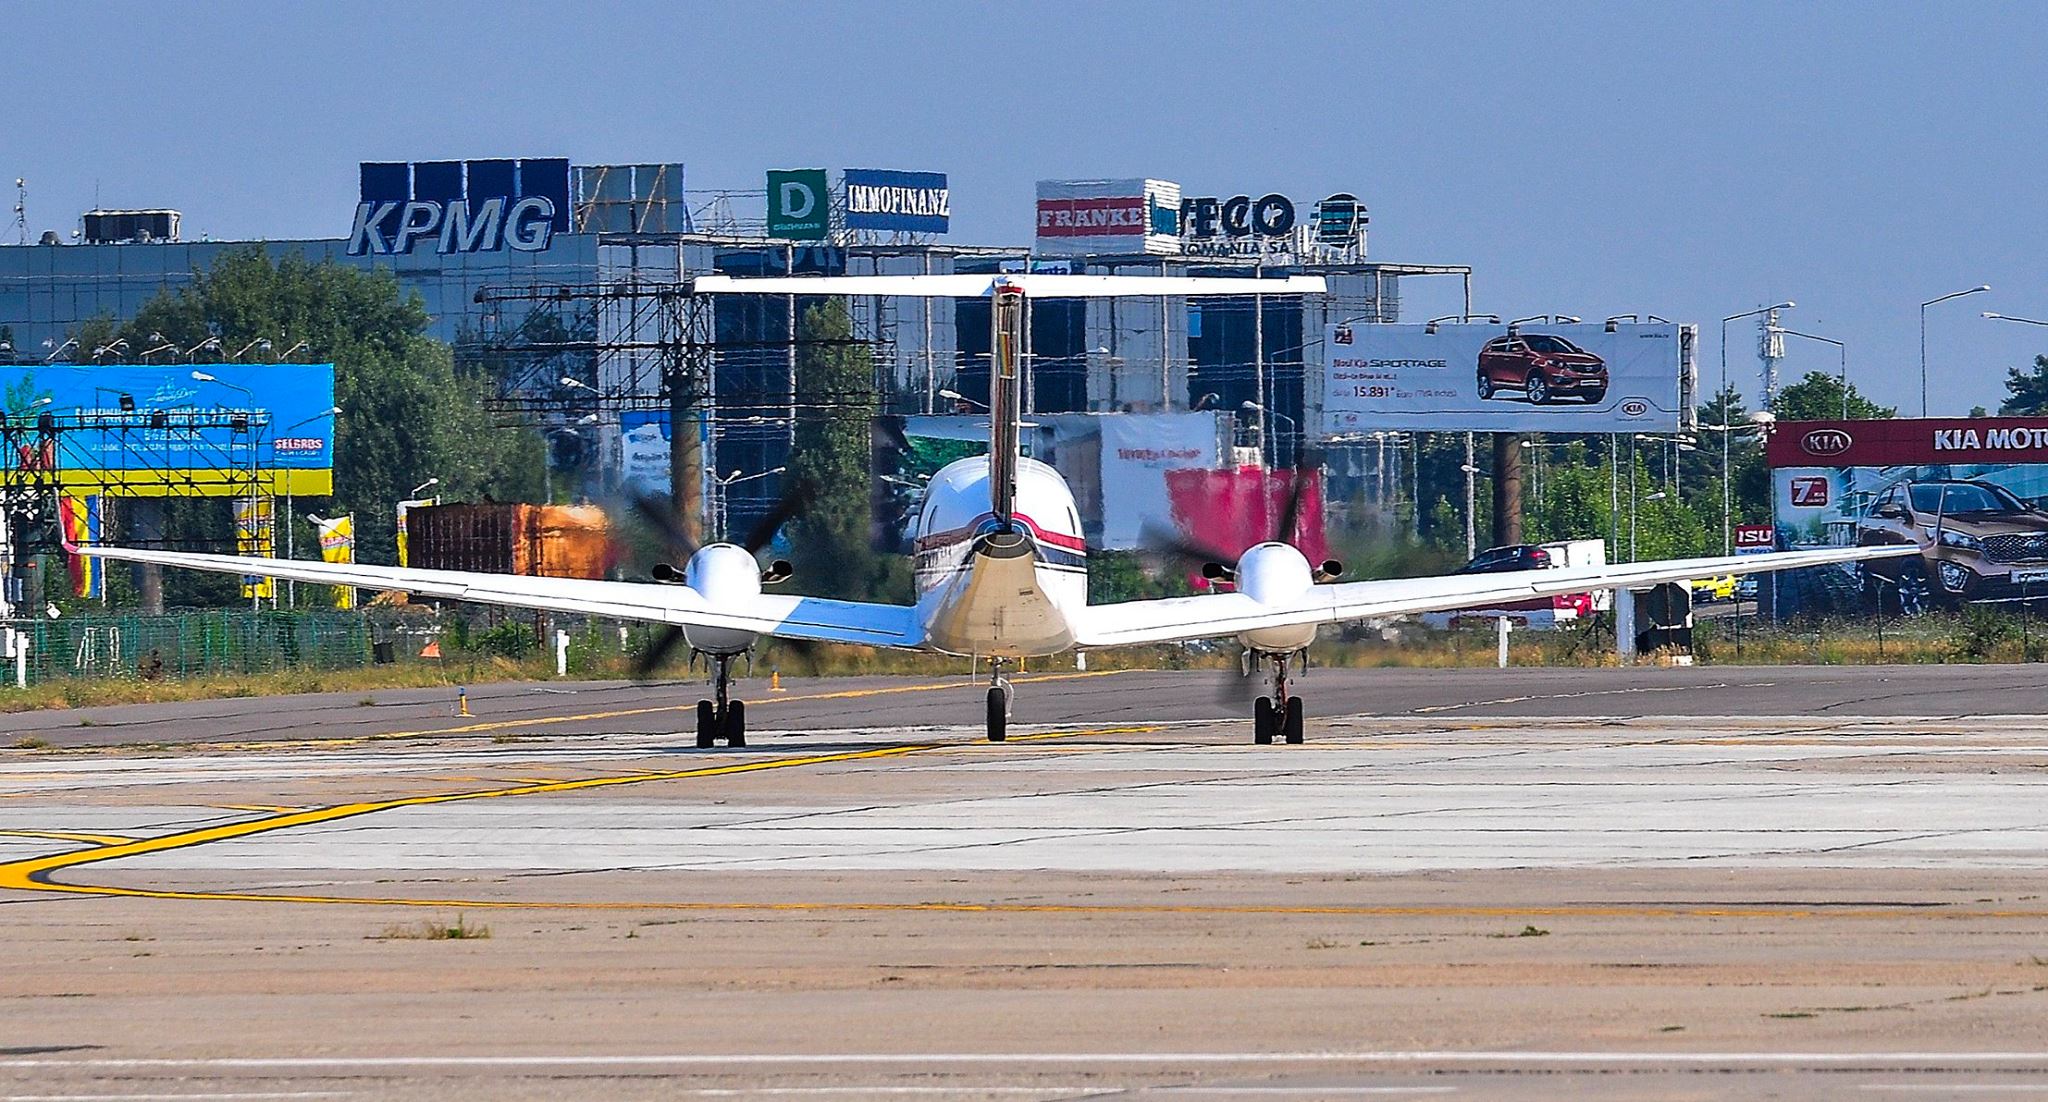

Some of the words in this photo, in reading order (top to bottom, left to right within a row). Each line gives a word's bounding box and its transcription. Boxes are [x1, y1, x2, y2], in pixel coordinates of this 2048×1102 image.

[781, 181, 815, 219] D
[848, 185, 950, 217] IMMOFINANZ
[346, 196, 556, 255] KPMG
[1038, 206, 1144, 227] FRANKE
[1369, 359, 1447, 368] SPORTAGE
[1808, 434, 1844, 450] KIA
[1934, 429, 1981, 450] KIA
[1985, 427, 2048, 449] MOT
[1793, 480, 1813, 503] 7
